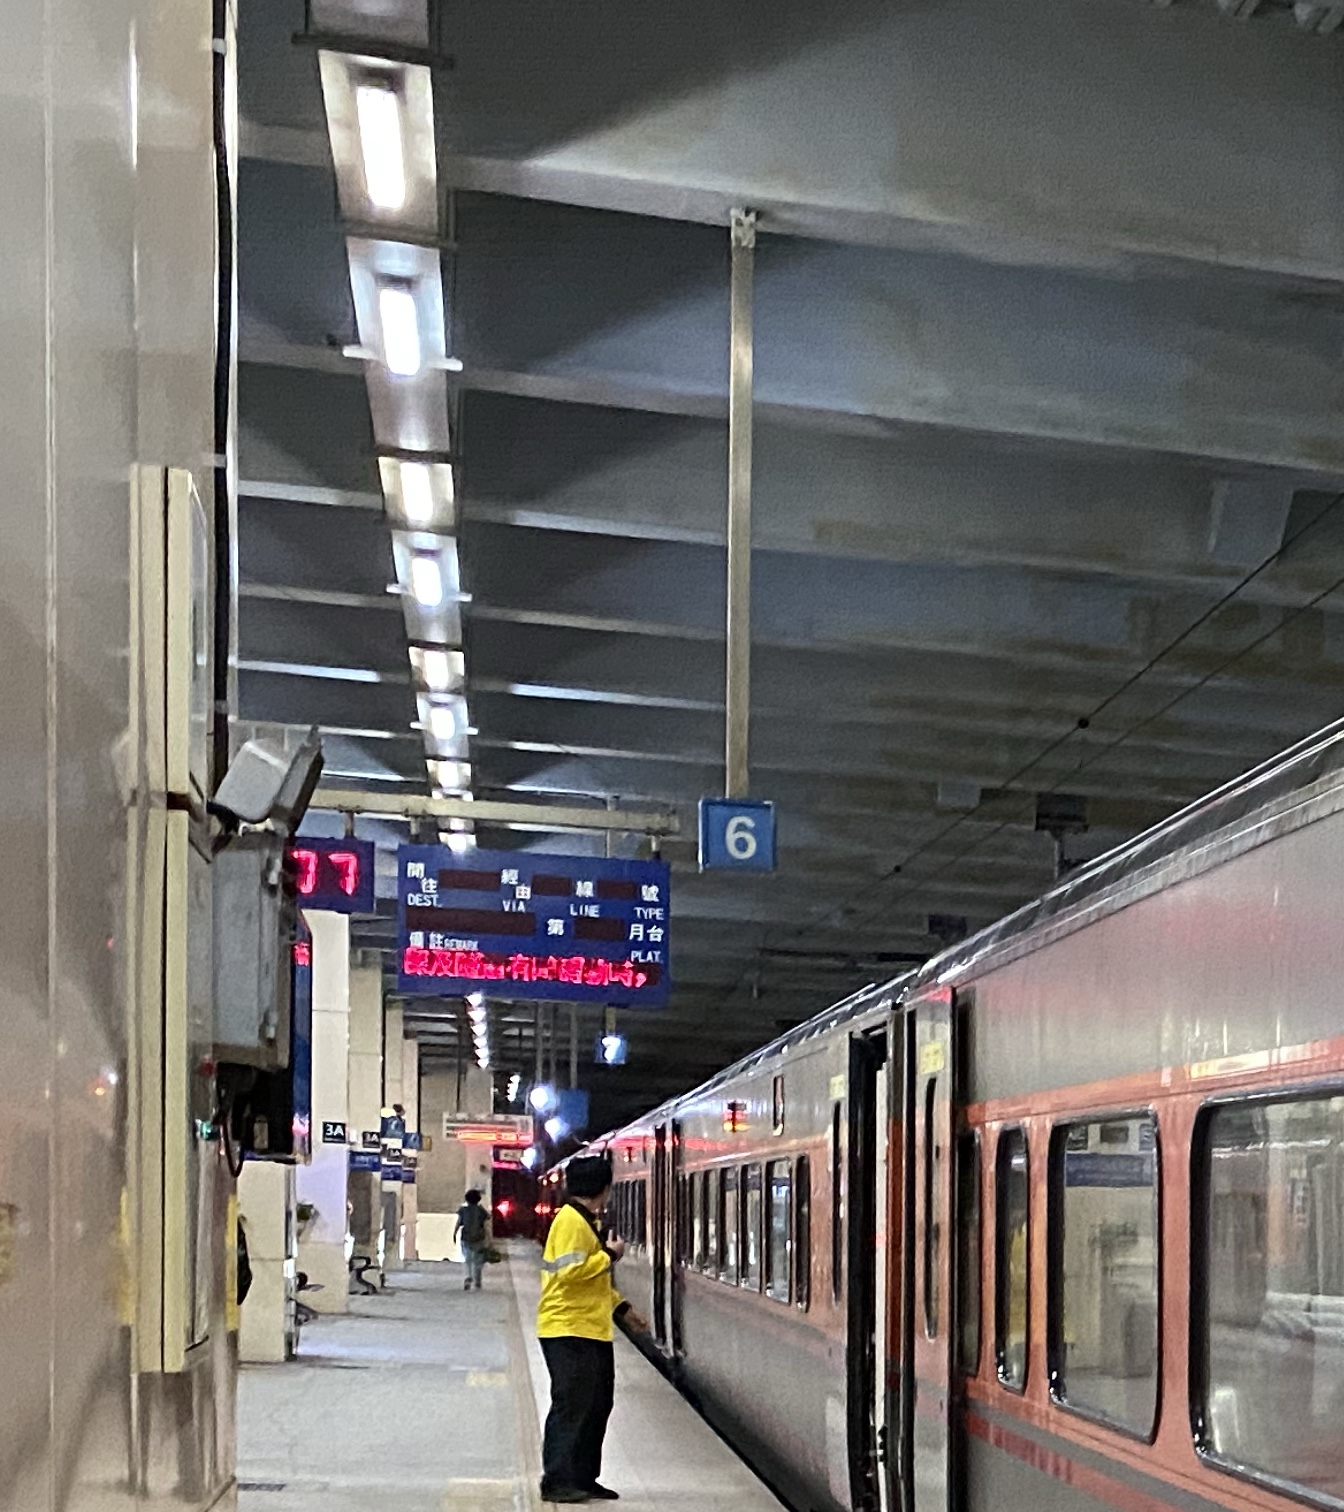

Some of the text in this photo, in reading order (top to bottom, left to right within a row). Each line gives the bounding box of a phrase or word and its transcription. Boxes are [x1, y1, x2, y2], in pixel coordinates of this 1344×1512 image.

[726, 816, 757, 860] 6
[502, 900, 526, 912] VIA
[570, 904, 601, 918] LINE
[634, 907, 664, 920] TYPE
[629, 924, 664, 942] 月台
[326, 1123, 344, 1136] 3A
